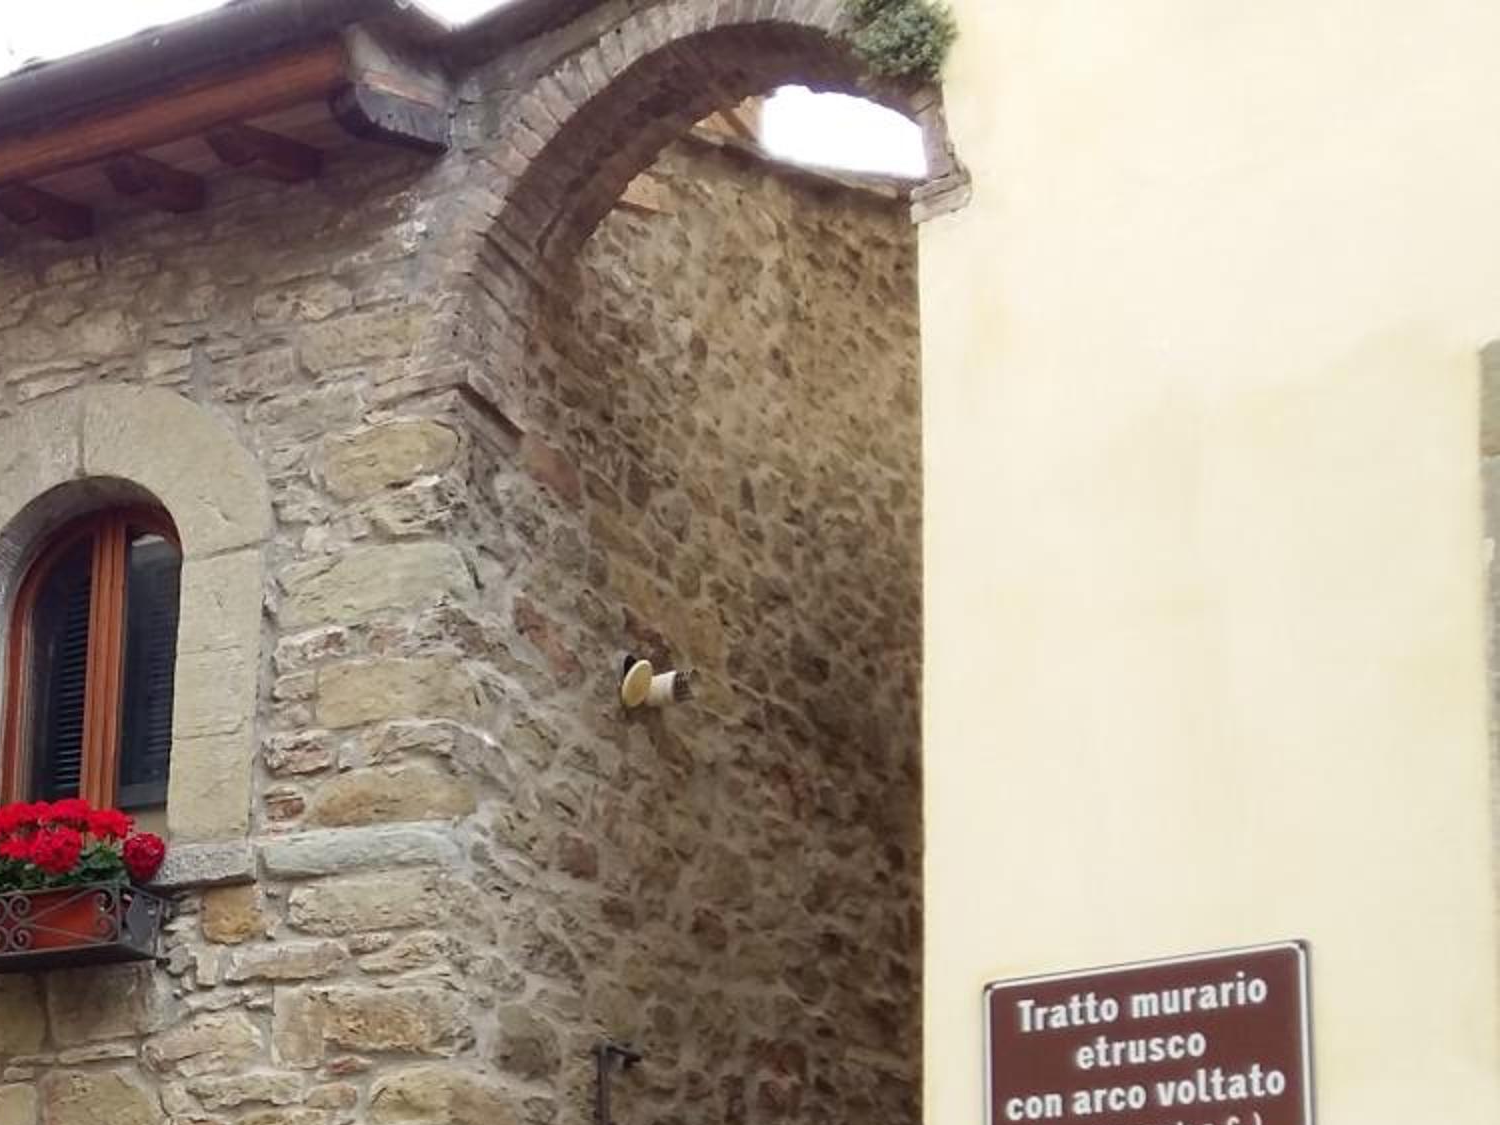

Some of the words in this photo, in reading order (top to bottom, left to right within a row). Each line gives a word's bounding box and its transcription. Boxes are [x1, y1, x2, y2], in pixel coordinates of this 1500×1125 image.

[1017, 992, 1119, 1033] Tratto
[1130, 972, 1267, 1019] murario
[1075, 1031, 1206, 1070] etrusco
[1006, 1090, 1062, 1121] con
[1072, 1085, 1146, 1115] arco
[1156, 1064, 1286, 1107] voltato
